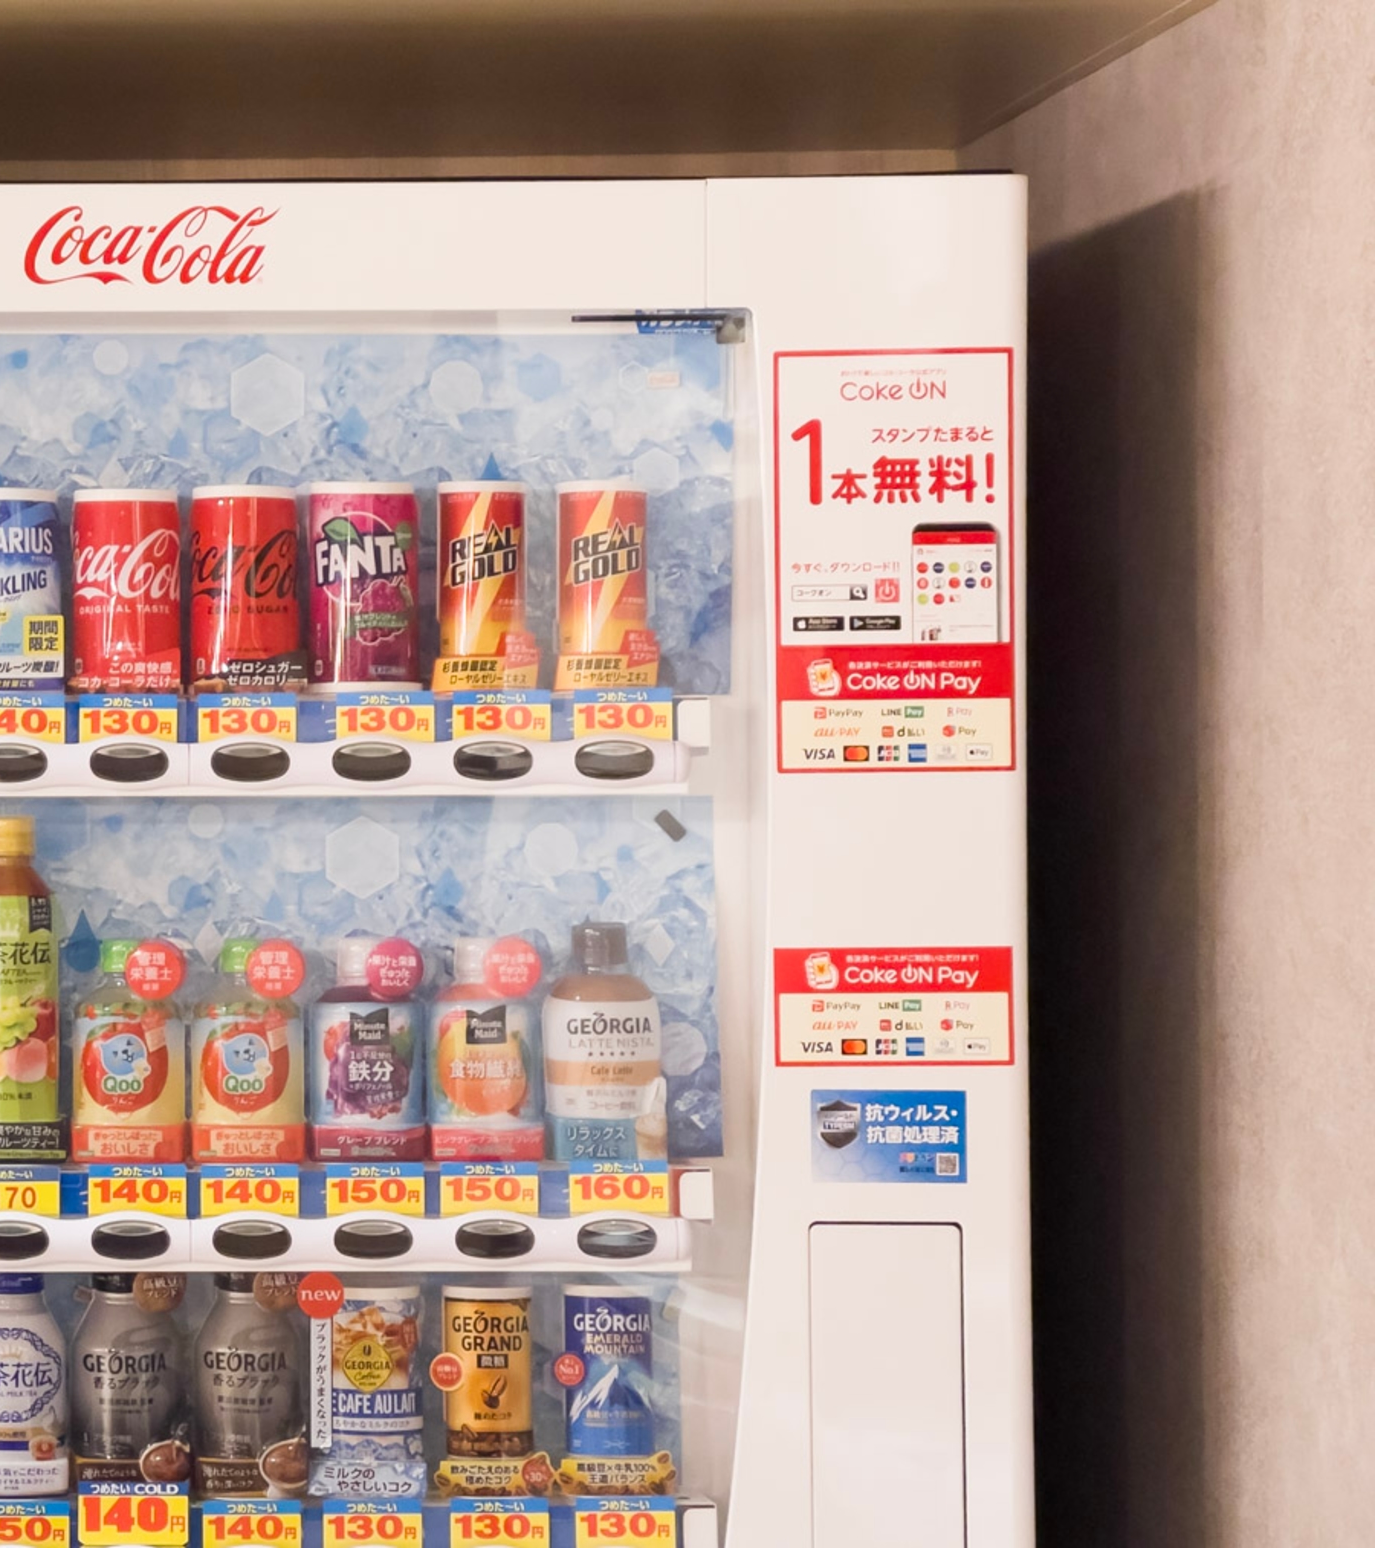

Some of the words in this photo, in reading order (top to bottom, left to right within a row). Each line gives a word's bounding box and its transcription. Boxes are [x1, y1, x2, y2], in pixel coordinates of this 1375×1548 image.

[24, 205, 281, 285] Coca-Cola
[840, 381, 903, 401] Coke
[909, 378, 946, 399] ON
[872, 426, 994, 443] スタンプたまると
[791, 418, 995, 505] 1本無料!
[573, 518, 640, 561] REAL
[316, 534, 406, 585] FANTA
[573, 549, 640, 585] GOLD
[450, 549, 517, 587] GOLD
[28, 620, 58, 634] 期間
[28, 636, 58, 651] 限定
[229, 661, 303, 674] ゼロシュガー
[847, 673, 900, 690] Coke
[904, 670, 935, 690] ON
[941, 672, 981, 694] Pay
[83, 709, 171, 734] 130円
[202, 709, 290, 734] 130円
[341, 707, 428, 732] 130円
[457, 706, 545, 731] 130円
[578, 704, 667, 729] 130円
[828, 709, 863, 718] PayPay
[958, 727, 977, 736] Pay
[804, 749, 835, 759] VISA
[137, 952, 165, 966] 管理
[259, 951, 288, 965] 管理
[130, 967, 172, 981] 栄養士
[252, 966, 295, 980] 栄養士
[844, 966, 897, 984] Coke
[902, 964, 933, 983] ON
[938, 966, 979, 988] Pay
[827, 1002, 861, 1011] PayPay
[879, 1002, 899, 1010] LINE
[354, 1022, 386, 1031] Minute
[471, 1019, 503, 1029] Minute
[567, 1012, 652, 1035] GEORGIA
[837, 1021, 858, 1030] PAY
[956, 1021, 974, 1030] Pay
[358, 1031, 382, 1040] Maid
[475, 1029, 501, 1038] Maid
[801, 1042, 833, 1053] VISA
[348, 1062, 394, 1082] 鉄分
[103, 1076, 142, 1092] Qoo
[225, 1076, 263, 1092] Qoo
[567, 1126, 626, 1141] リラックス
[866, 1126, 959, 1144] 抗菌処理済
[101, 1142, 149, 1155] おいしさ
[223, 1142, 272, 1155] おいしさ
[574, 1144, 618, 1157] タイムに
[94, 1179, 182, 1203] 140円
[206, 1179, 294, 1203] 140円
[331, 1179, 420, 1203] 150円
[446, 1177, 534, 1201] 150円
[575, 1174, 664, 1199] 160円
[301, 1289, 341, 1302] new
[453, 1310, 529, 1333] GEORGIA
[574, 1307, 651, 1332] GEORGIA
[462, 1336, 522, 1352] GRAND
[587, 1334, 643, 1344] EMERALD
[584, 1344, 645, 1354] MOUNTAIN
[84, 1348, 166, 1374] GEORGIA
[204, 1346, 286, 1371] GEORGIA
[345, 1360, 391, 1370] GEORGIA
[94, 1377, 159, 1389] 香るブラック
[213, 1375, 279, 1388] 香るブラック
[339, 1394, 371, 1413] CAFE
[375, 1394, 392, 1413] AU
[394, 1394, 416, 1413] LAIT
[324, 1467, 375, 1480] ミルクの
[450, 1465, 519, 1474] 飲みごたえのある
[90, 1484, 131, 1494] つめたい
[134, 1484, 178, 1493] COLD
[337, 1481, 411, 1493] やさしいコク
[83, 1497, 185, 1533] 140円
[207, 1516, 297, 1539] 140円
[328, 1515, 416, 1540] 130円
[455, 1514, 544, 1539] 130円
[580, 1513, 670, 1538] 130円
